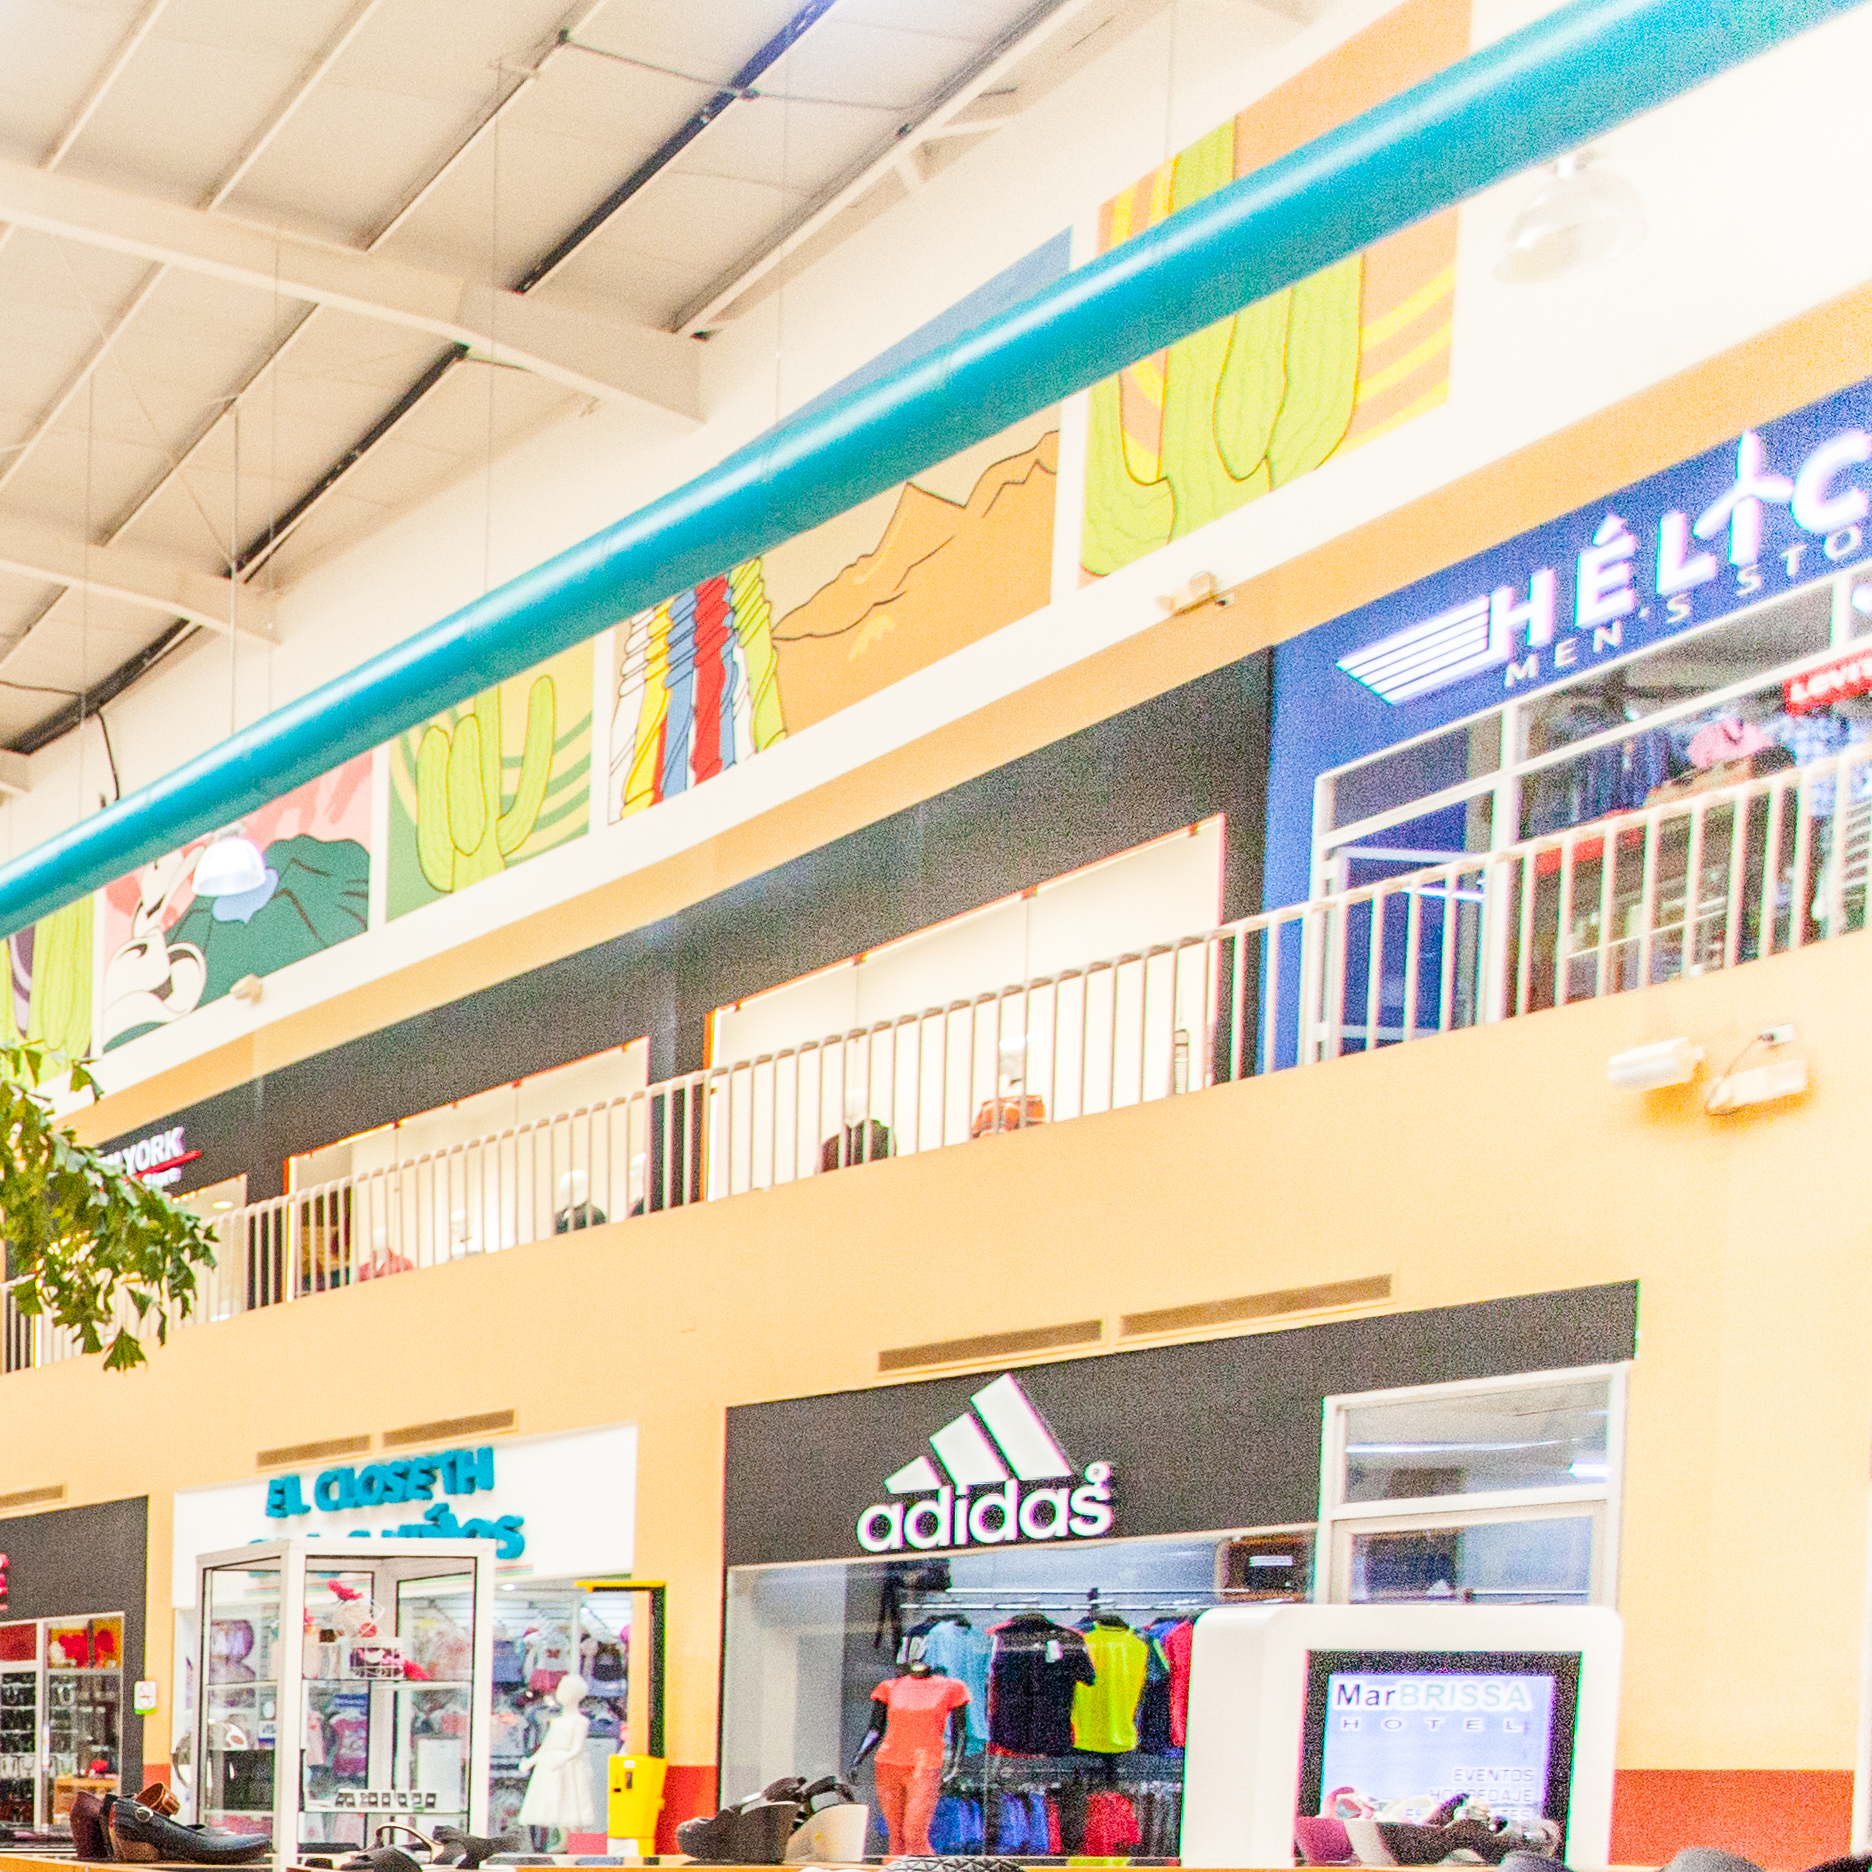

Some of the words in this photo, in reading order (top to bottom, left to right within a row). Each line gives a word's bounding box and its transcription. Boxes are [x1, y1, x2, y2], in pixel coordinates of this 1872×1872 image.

[1505, 592, 1691, 687] MEN'S
[122, 1126, 186, 1177] YORK
[265, 1475, 312, 1519] EL
[856, 1477, 1114, 1552] adidas
[1336, 1684, 1528, 1708] MarBRISSA
[1454, 1769, 1534, 1782] EVENTOS
